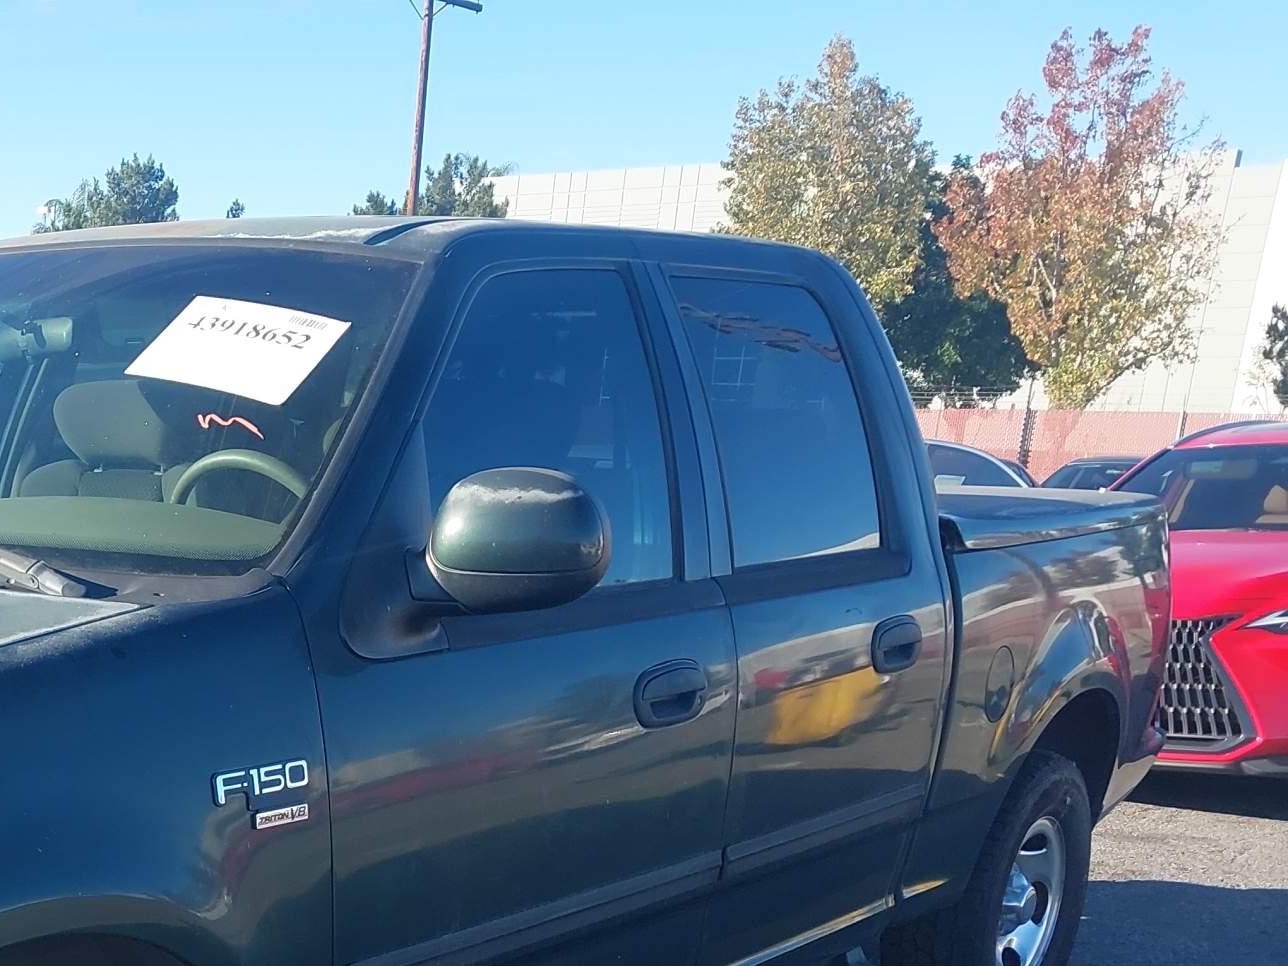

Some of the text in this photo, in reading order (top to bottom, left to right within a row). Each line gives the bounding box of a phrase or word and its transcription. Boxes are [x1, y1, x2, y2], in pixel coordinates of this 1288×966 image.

[187, 315, 312, 350] 43918652
[259, 806, 307, 825] TRITON V8
